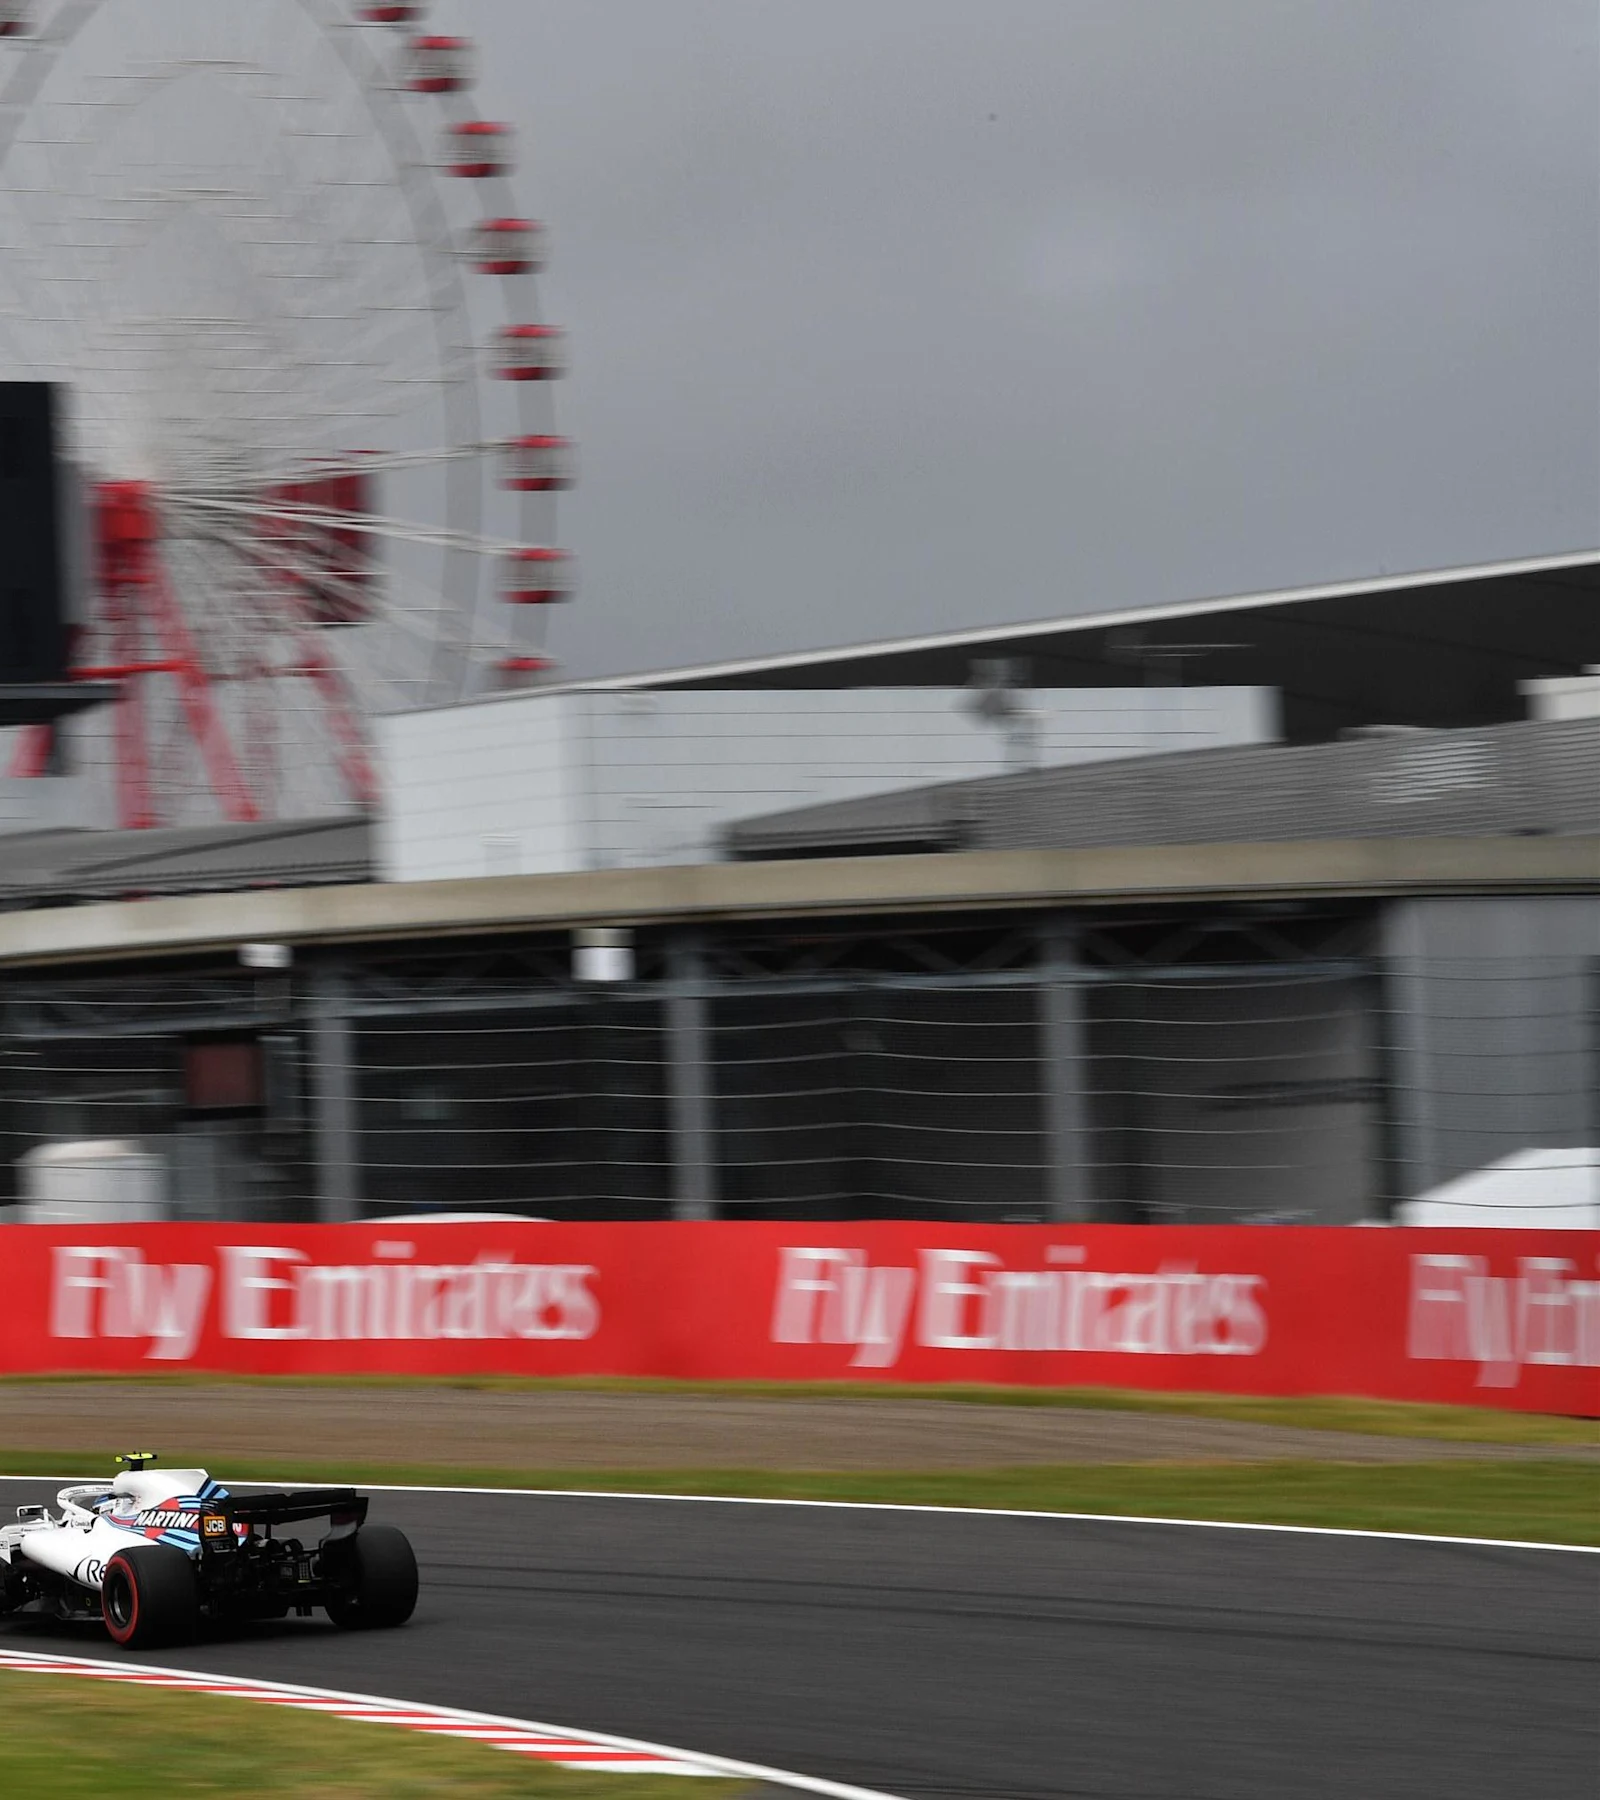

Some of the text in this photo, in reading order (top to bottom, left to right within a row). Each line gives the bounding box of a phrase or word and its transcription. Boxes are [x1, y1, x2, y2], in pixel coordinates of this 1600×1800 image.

[48, 1240, 598, 1360] Fly Emirates
[774, 1244, 1268, 1368] Fly Emirates
[1408, 1253, 1528, 1388] Fly
[133, 1510, 199, 1528] MARTINI
[205, 1520, 225, 1533] JCB
